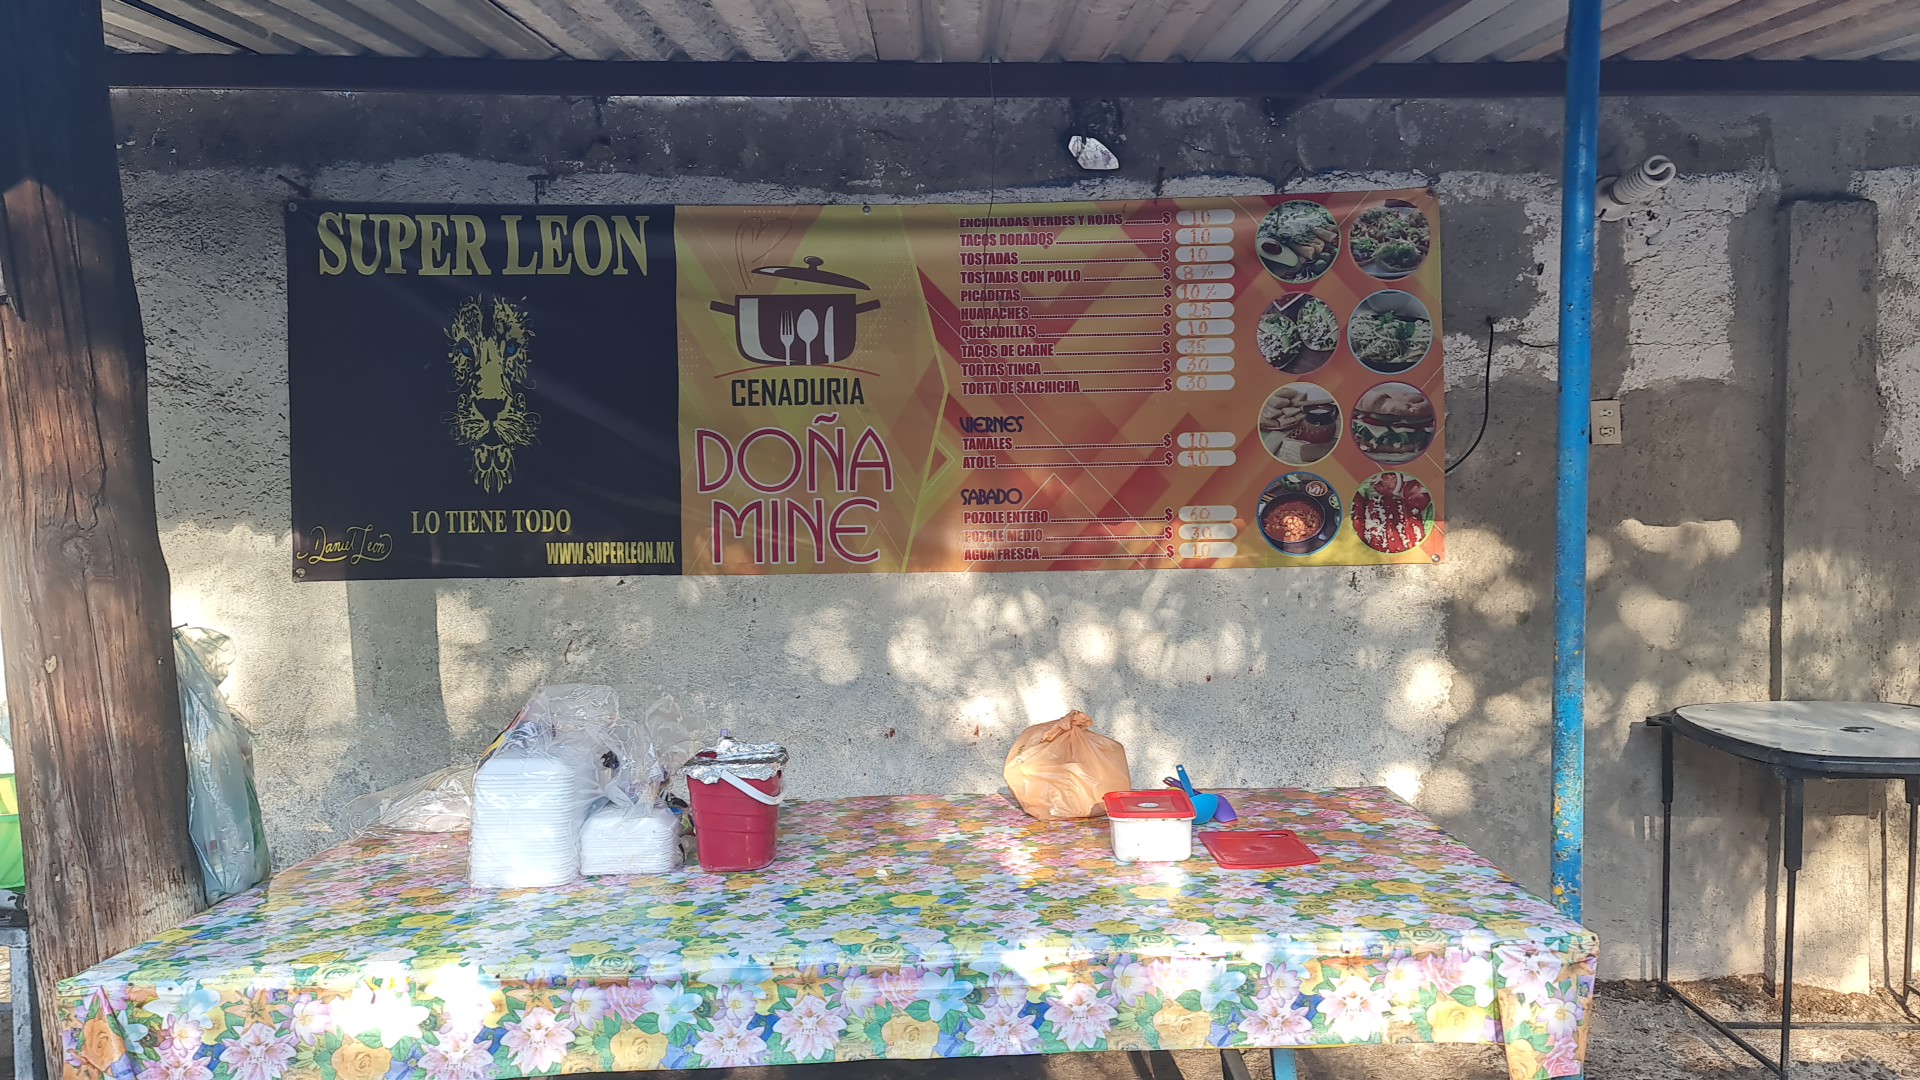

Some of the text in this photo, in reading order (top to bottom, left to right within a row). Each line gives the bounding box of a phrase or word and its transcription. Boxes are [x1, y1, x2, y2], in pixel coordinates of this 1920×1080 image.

[960, 217, 1030, 228] ENCHILADAS
[1032, 216, 1076, 226] VERDES
[1078, 215, 1086, 226] Y
[1088, 214, 1123, 226] ROJAS
[1162, 212, 1170, 224] $
[316, 212, 650, 276] SUPER LEON
[960, 229, 1211, 247] TACOS DORADOS $ 10
[960, 248, 1208, 265] TOSTADAS $ 10
[960, 271, 1020, 284] TOSTADAS
[1021, 270, 1044, 283] CON
[1047, 270, 1081, 282] POLLO
[1163, 266, 1172, 281] $
[1183, 266, 1194, 280] 8
[960, 289, 1020, 302] PICADITAS
[1163, 284, 1172, 299] $
[1180, 284, 1200, 300] 10
[960, 302, 1211, 320] HUARACHES $ 25
[960, 321, 1208, 340] QUESADILLAS $ 10
[961, 345, 996, 358] TACOS
[999, 344, 1014, 357] DE
[1016, 344, 1054, 356] CARNE
[1162, 340, 1170, 355] $
[962, 358, 1209, 376] TORTAS TINGA $ 30
[731, 378, 864, 406] CENADURIA
[962, 376, 1208, 394] TORTA DE SALCHICHA $ 30
[960, 416, 1024, 433] VIERNES
[962, 432, 1209, 450] TAMALES $ 10
[694, 411, 894, 494] DOÑA
[962, 451, 1209, 469] ATOLE $ 10
[960, 488, 1022, 506] SABADO
[411, 509, 571, 535] LO TIENE TODO
[963, 511, 1004, 524] POZOLE
[1006, 510, 1049, 524] ENTERO
[1164, 508, 1172, 522] $
[711, 497, 880, 565] MINE
[964, 526, 1212, 542] POZOLE MEDIO $ 30
[546, 542, 675, 564] WWW.SUPERLEON.MX
[964, 542, 1212, 561] AGUA FRESCA $ 10
